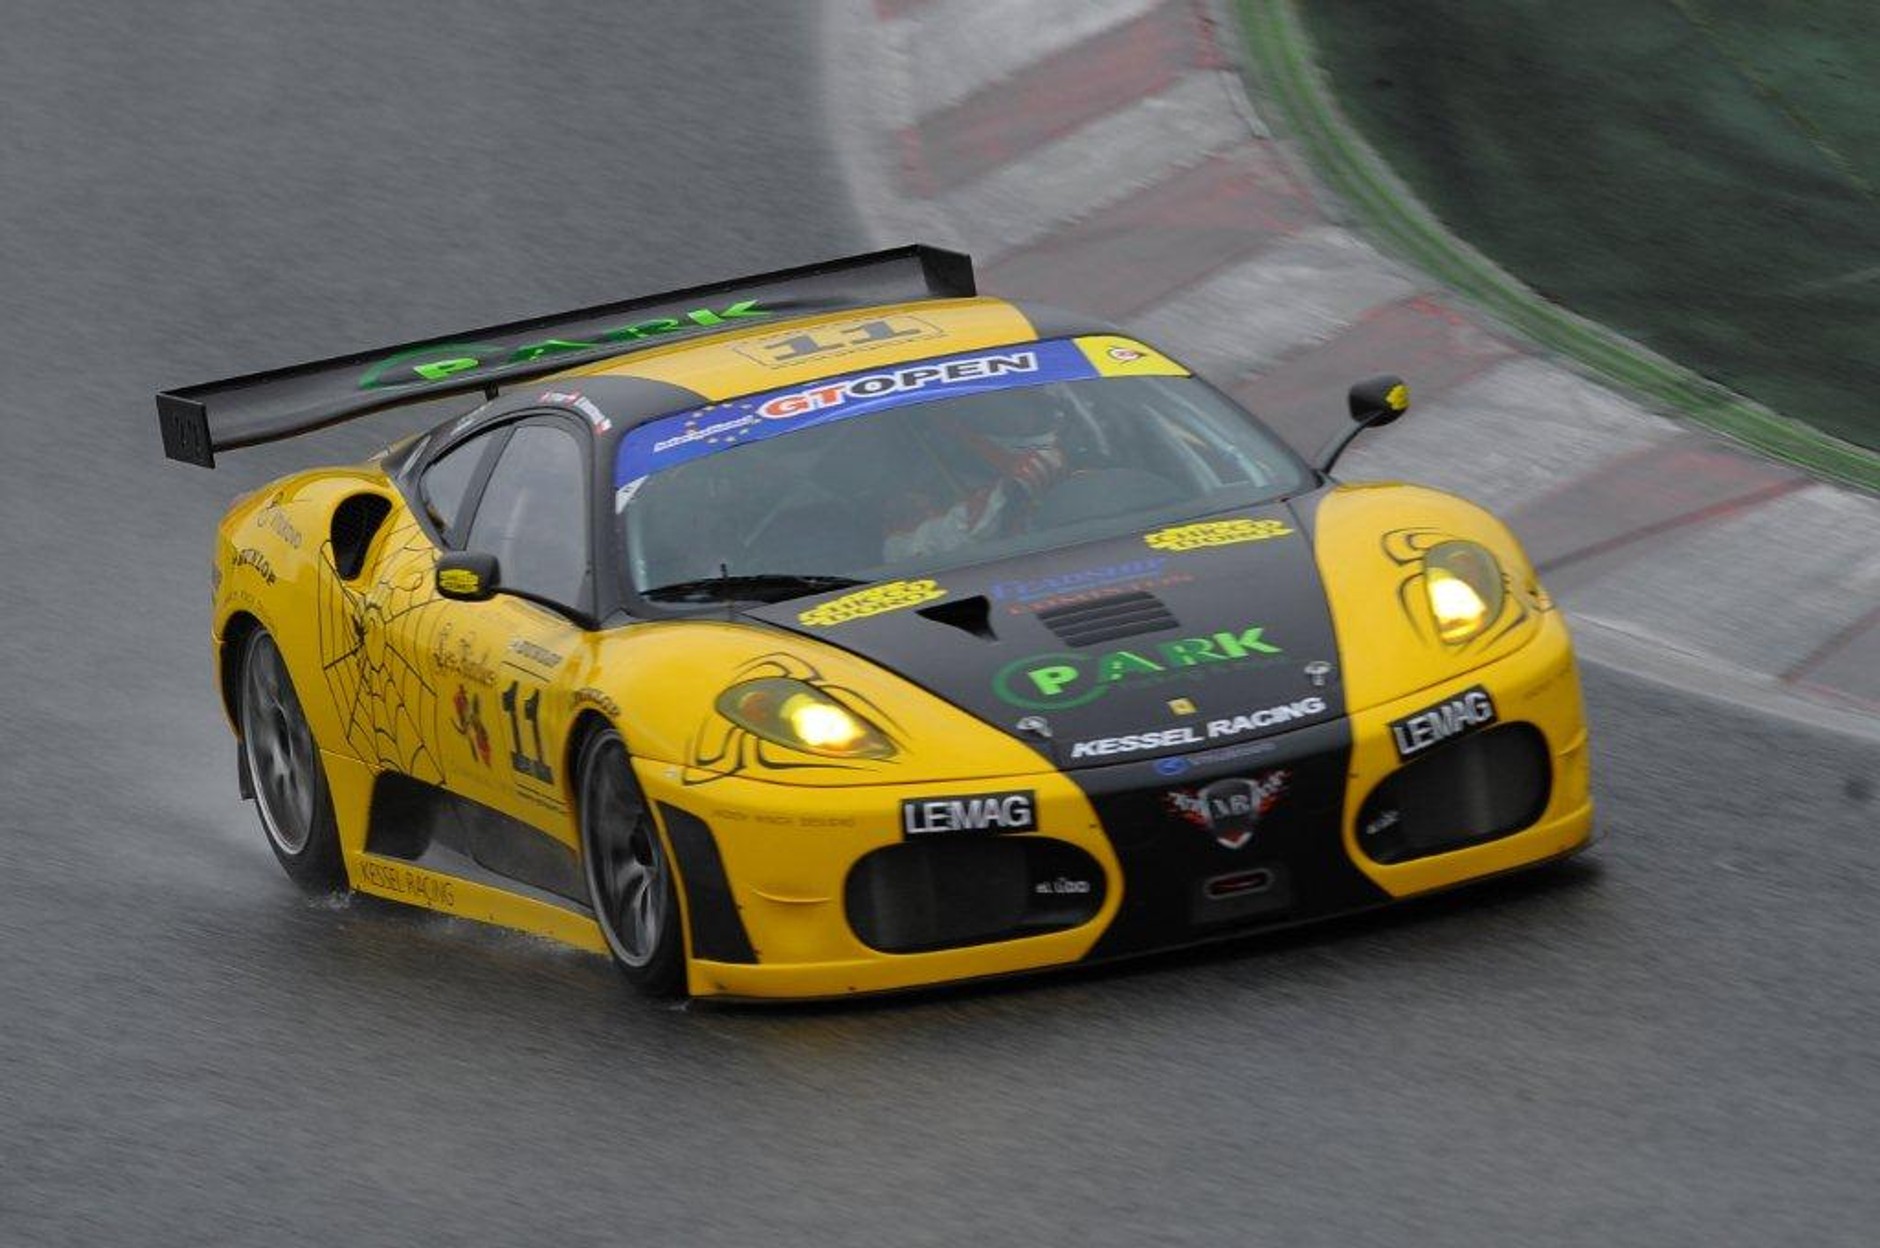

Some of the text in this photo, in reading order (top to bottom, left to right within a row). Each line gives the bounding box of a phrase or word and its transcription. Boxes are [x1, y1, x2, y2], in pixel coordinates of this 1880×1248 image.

[411, 300, 772, 381] PARK
[763, 318, 922, 361] 11
[1026, 625, 1282, 696] PARK
[502, 679, 556, 786] 11
[1070, 725, 1203, 760] KESSEL
[1206, 696, 1329, 740] RACING
[1394, 689, 1494, 757] LEMAG
[903, 794, 1034, 836] LEMAG
